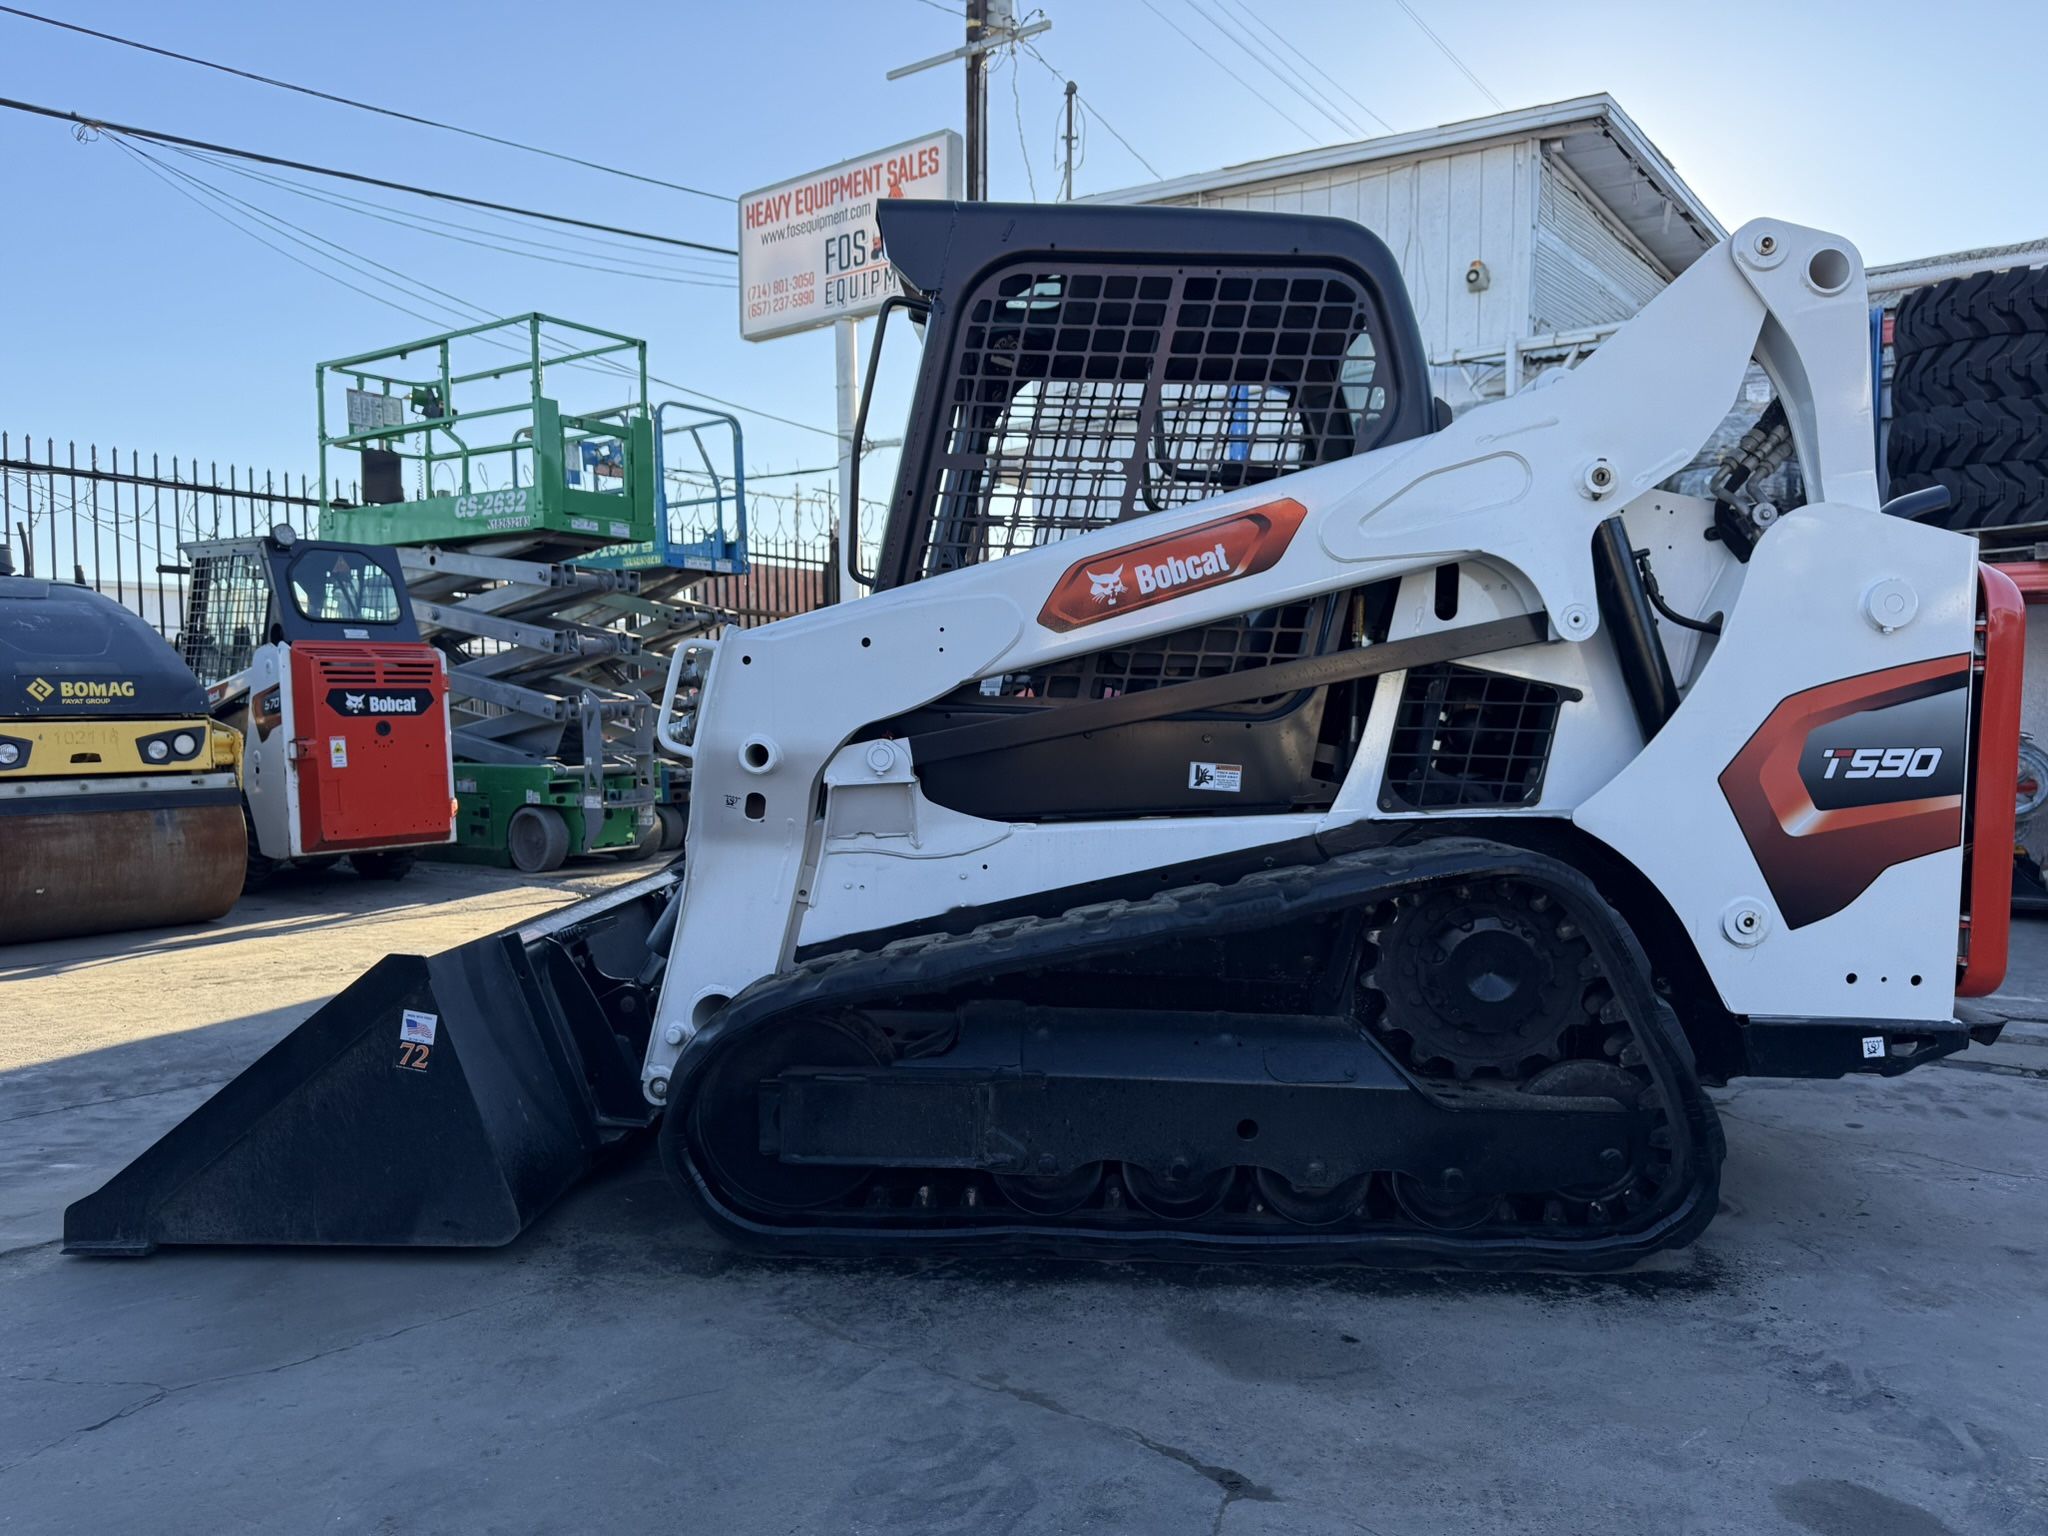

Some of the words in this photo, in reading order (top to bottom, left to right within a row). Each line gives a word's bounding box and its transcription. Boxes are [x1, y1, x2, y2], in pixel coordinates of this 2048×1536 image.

[745, 193, 793, 230] HEAVY
[795, 163, 883, 216] EQUIPMENT
[887, 146, 940, 188] SALES
[760, 203, 872, 246] www.fosequipment.com
[825, 229, 866, 275] FOS
[747, 282, 771, 303] (714)
[772, 271, 815, 295] 801-3050
[747, 300, 771, 320] (657)
[772, 289, 815, 313] 237-5990
[455, 490, 527, 518] GS-2632
[1134, 543, 1230, 595] Bobcat
[60, 681, 135, 697] BOMAG
[369, 696, 417, 713] Bobcat
[1823, 747, 1943, 779] T590
[400, 1042, 430, 1069] 72
